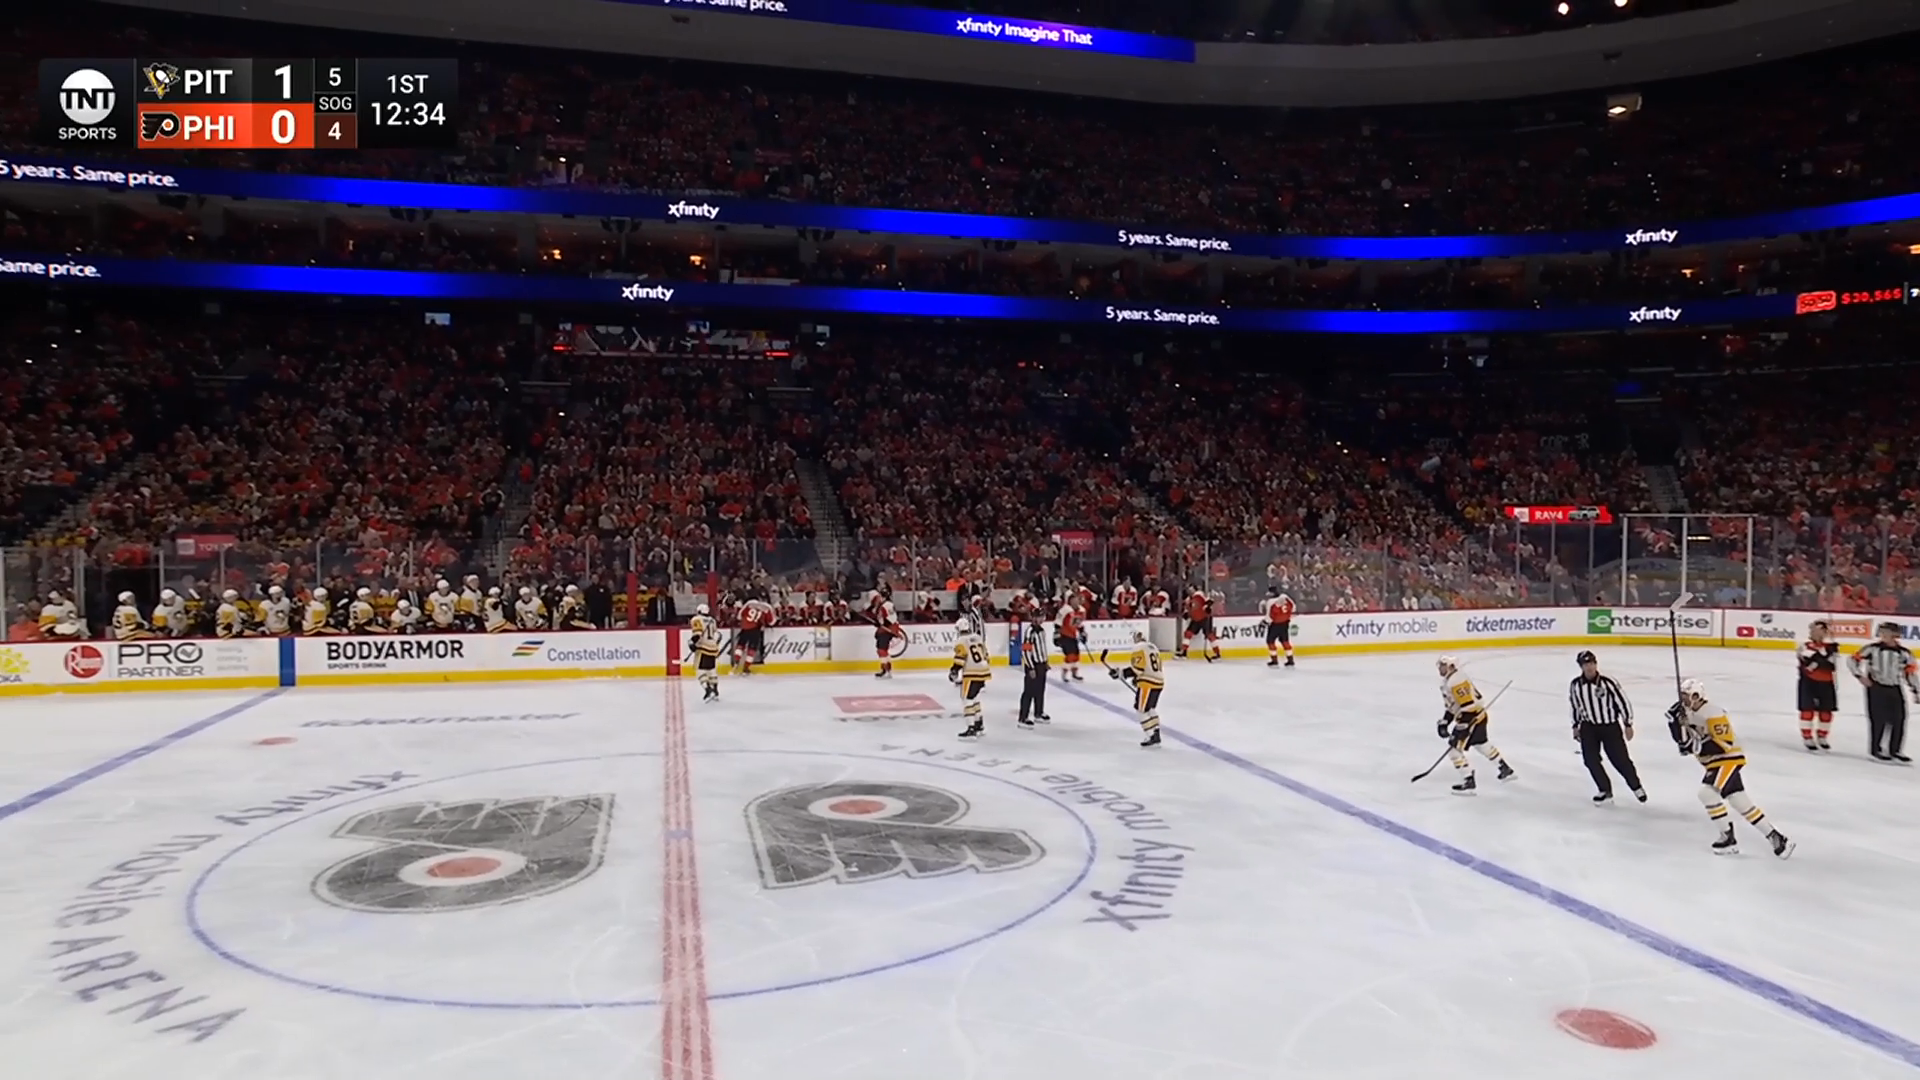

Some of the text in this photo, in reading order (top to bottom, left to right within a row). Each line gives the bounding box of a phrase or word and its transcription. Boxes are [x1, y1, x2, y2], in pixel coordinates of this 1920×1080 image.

[749, 0, 788, 12] price.
[956, 17, 1093, 46] xfinity Imagine That
[11, 163, 71, 180] years.
[73, 165, 126, 184] Same
[128, 170, 179, 188] price.
[667, 200, 720, 219] xfinity
[1118, 230, 1232, 251] 5 years. Same price.
[1625, 228, 1679, 246] xfinity
[48, 260, 101, 279] price.
[621, 283, 675, 302] xfinity
[1106, 306, 1220, 326] 5 years. Same price.
[1629, 306, 1682, 323] xfinity
[1534, 510, 1564, 521] RAV4
[747, 608, 763, 623] 91
[1466, 616, 1556, 633] ticketmaster
[1336, 618, 1438, 638] xfinity mobile
[1757, 627, 1796, 639] YouTube
[118, 642, 203, 666] PRO
[326, 640, 464, 661] BODYARMOR
[547, 646, 641, 662] Constellation
[117, 665, 204, 678] PARTNER
[1713, 723, 1730, 735] 57
[1083, 838, 1196, 932] xfinity
